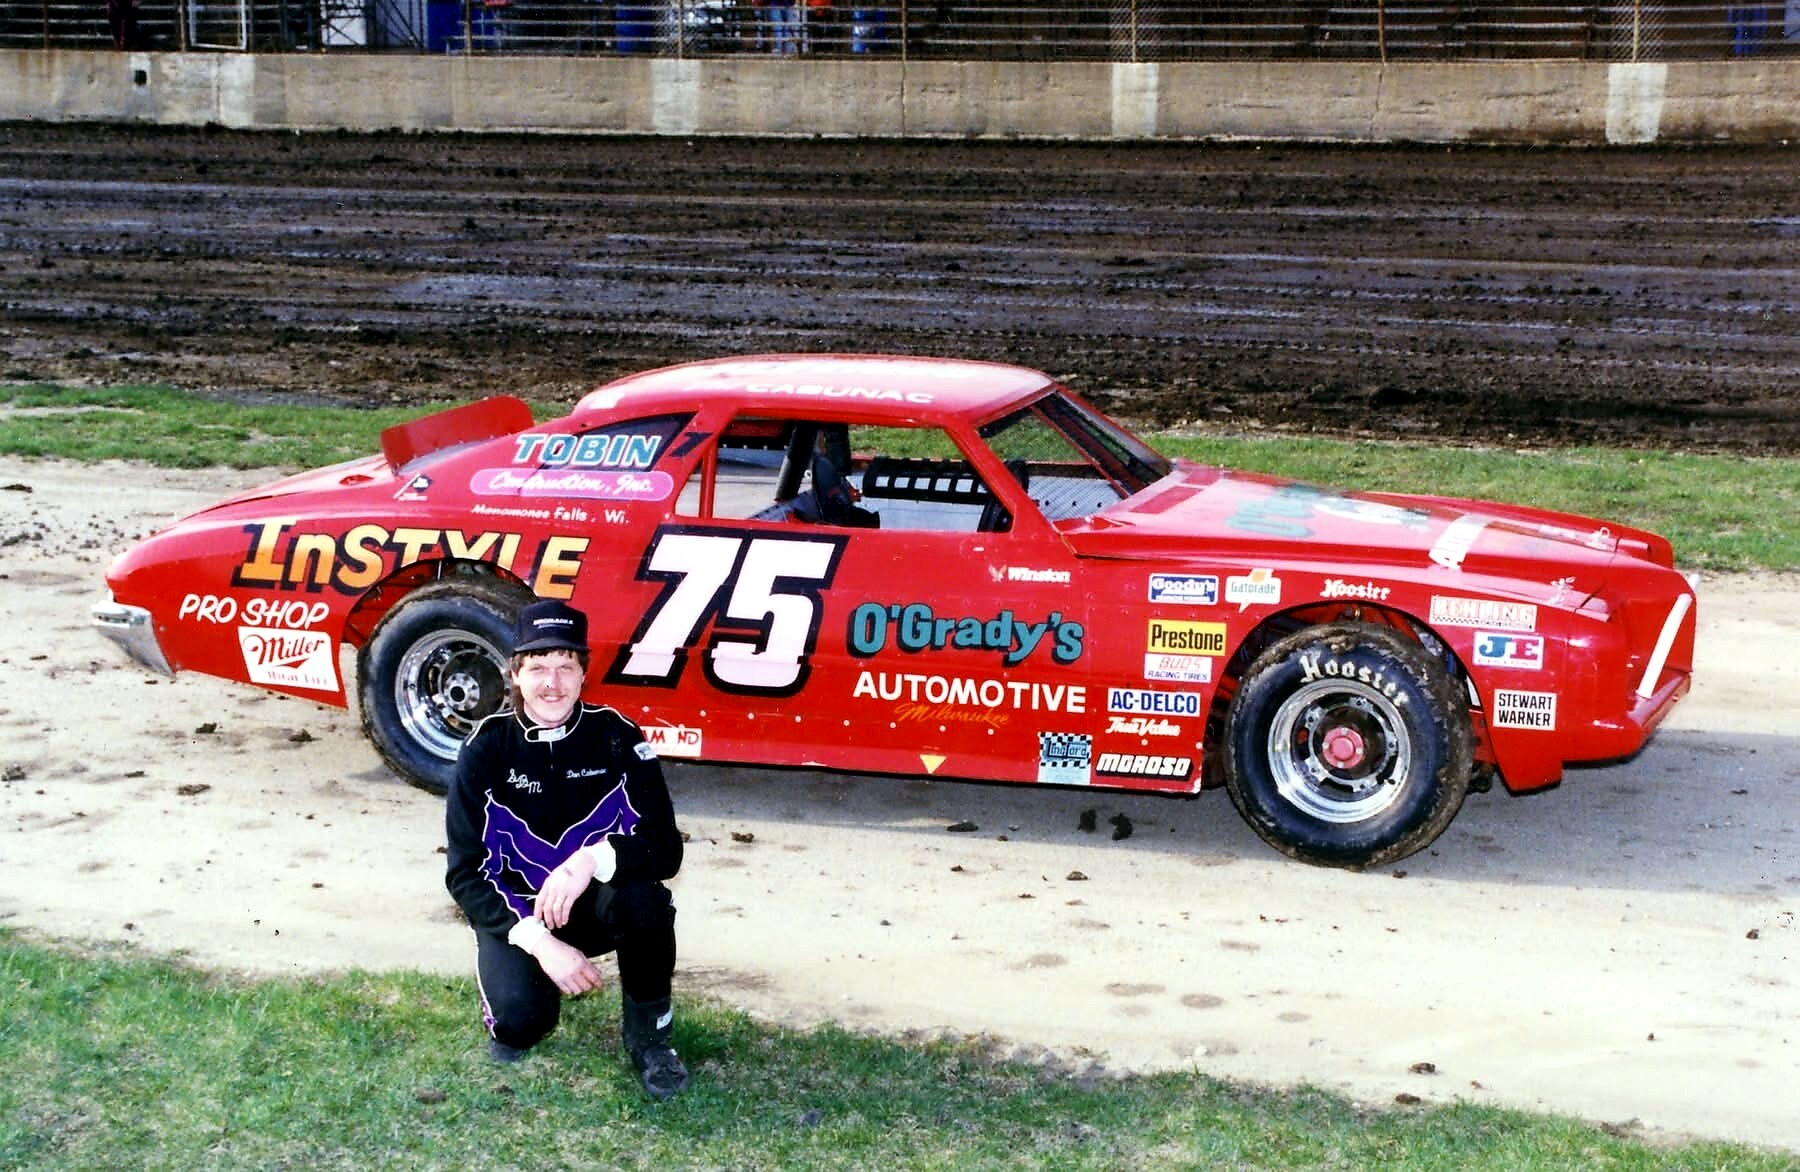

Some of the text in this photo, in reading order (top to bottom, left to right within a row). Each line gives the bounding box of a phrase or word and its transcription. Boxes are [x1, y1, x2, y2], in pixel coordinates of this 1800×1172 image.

[512, 432, 663, 468] TOBIN
[604, 509, 630, 524] Wi.
[1008, 566, 1071, 583] Winston
[1152, 577, 1216, 595] Goody's
[1231, 582, 1276, 595] Gatorade
[1320, 579, 1391, 600] Hoosier
[178, 593, 330, 629] PRO SHOP
[604, 526, 849, 696] 75
[847, 602, 1084, 668] O'Grady's
[1151, 624, 1223, 651] Prestone
[243, 634, 325, 666] Miller
[1478, 636, 1540, 660] JE
[1148, 670, 1208, 681] RACING TIRES
[1300, 651, 1409, 707] Hoosier
[853, 671, 1086, 713] AUTOMOTIVE
[1111, 690, 1198, 714] AC-DELCO
[1498, 692, 1553, 710] STEWART
[894, 702, 1010, 728] Milwaukee
[1498, 709, 1551, 727] WARNER
[1096, 753, 1192, 777] MOROSO
